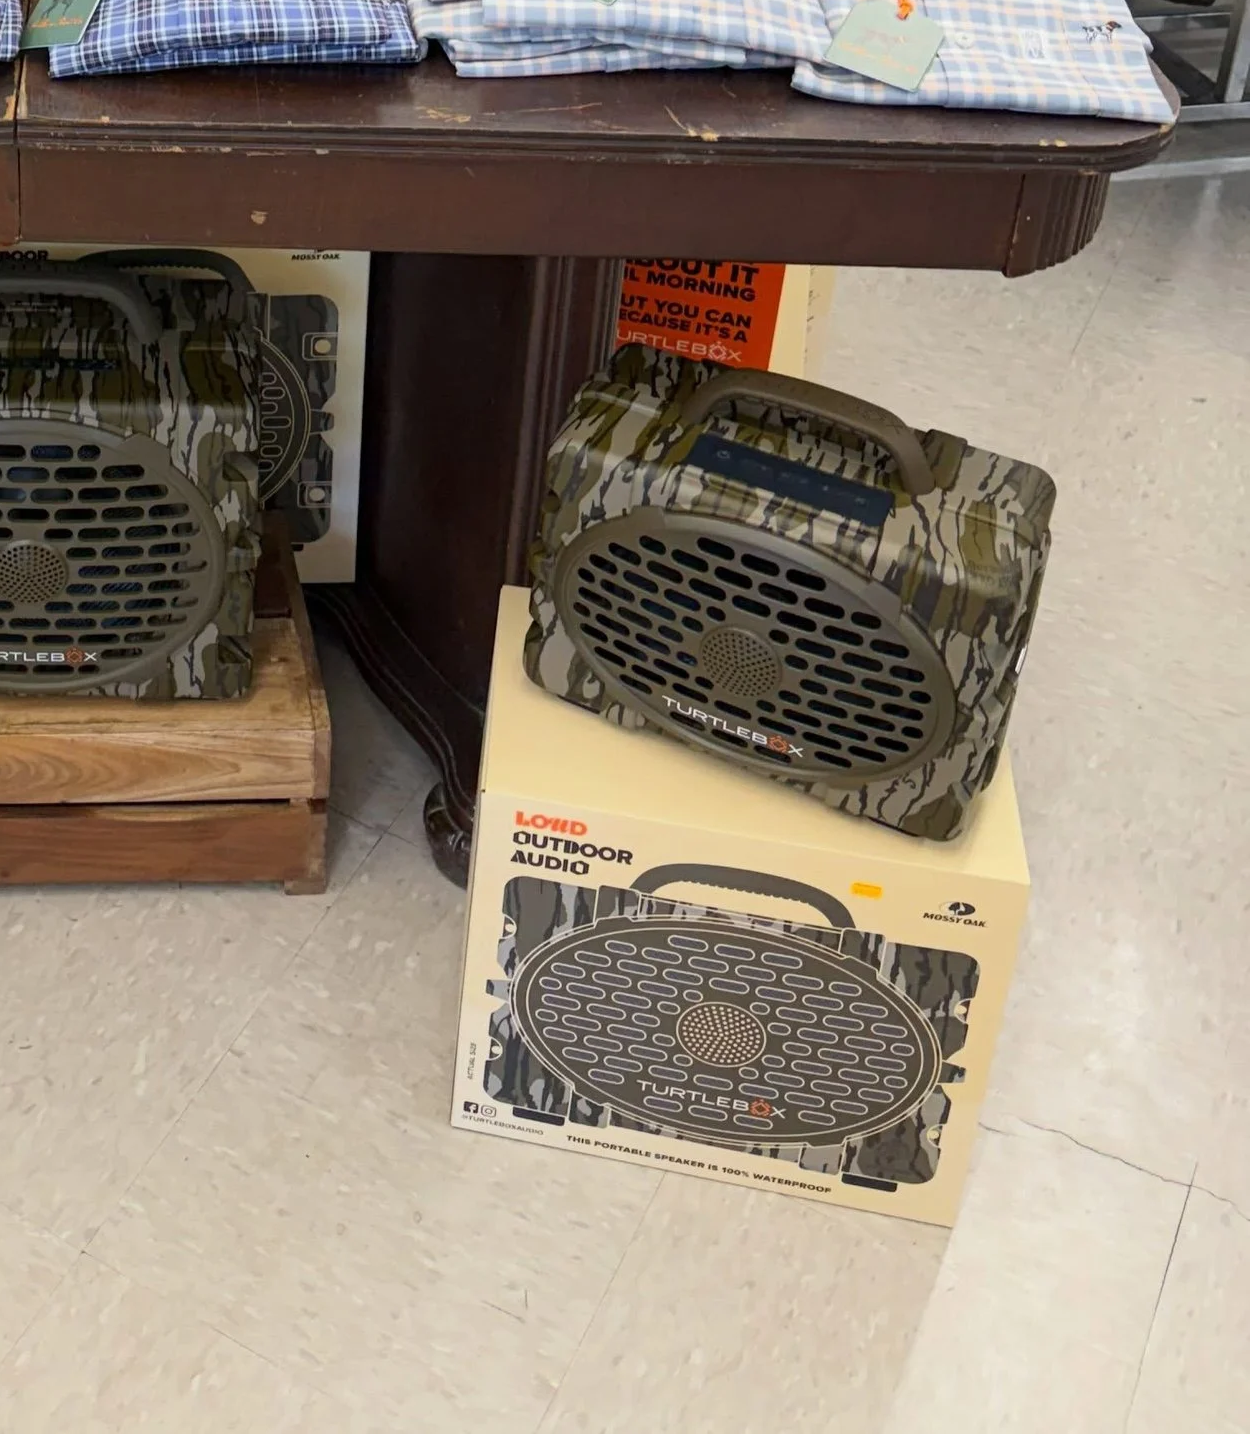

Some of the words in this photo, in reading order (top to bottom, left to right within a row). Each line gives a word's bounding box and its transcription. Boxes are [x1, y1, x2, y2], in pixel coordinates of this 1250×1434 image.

[322, 253, 342, 261] OAK
[623, 271, 641, 283] IL
[646, 271, 756, 302] MORNING
[618, 310, 690, 333] ECAUSE
[695, 322, 730, 340] IT'S
[734, 330, 748, 343] A
[620, 293, 648, 308] UT
[654, 299, 699, 318] YOU
[704, 309, 752, 329] CAN
[616, 330, 742, 362] URTLEBOX
[661, 695, 804, 758] TURTLEBOX
[515, 810, 588, 836] LOUD
[510, 850, 590, 875] AUDIO
[513, 830, 633, 865] OUTDOOR
[923, 912, 963, 924] MOSSY
[963, 918, 987, 928] OAK
[636, 1079, 786, 1119] TURTLEBOX
[566, 1134, 591, 1146] THIS
[594, 1141, 651, 1158] PORTABLE
[654, 1153, 705, 1168] SPEAKER
[707, 1164, 719, 1172] IS
[722, 1167, 749, 1178] 100%
[753, 1173, 832, 1194] WATERPROOF
